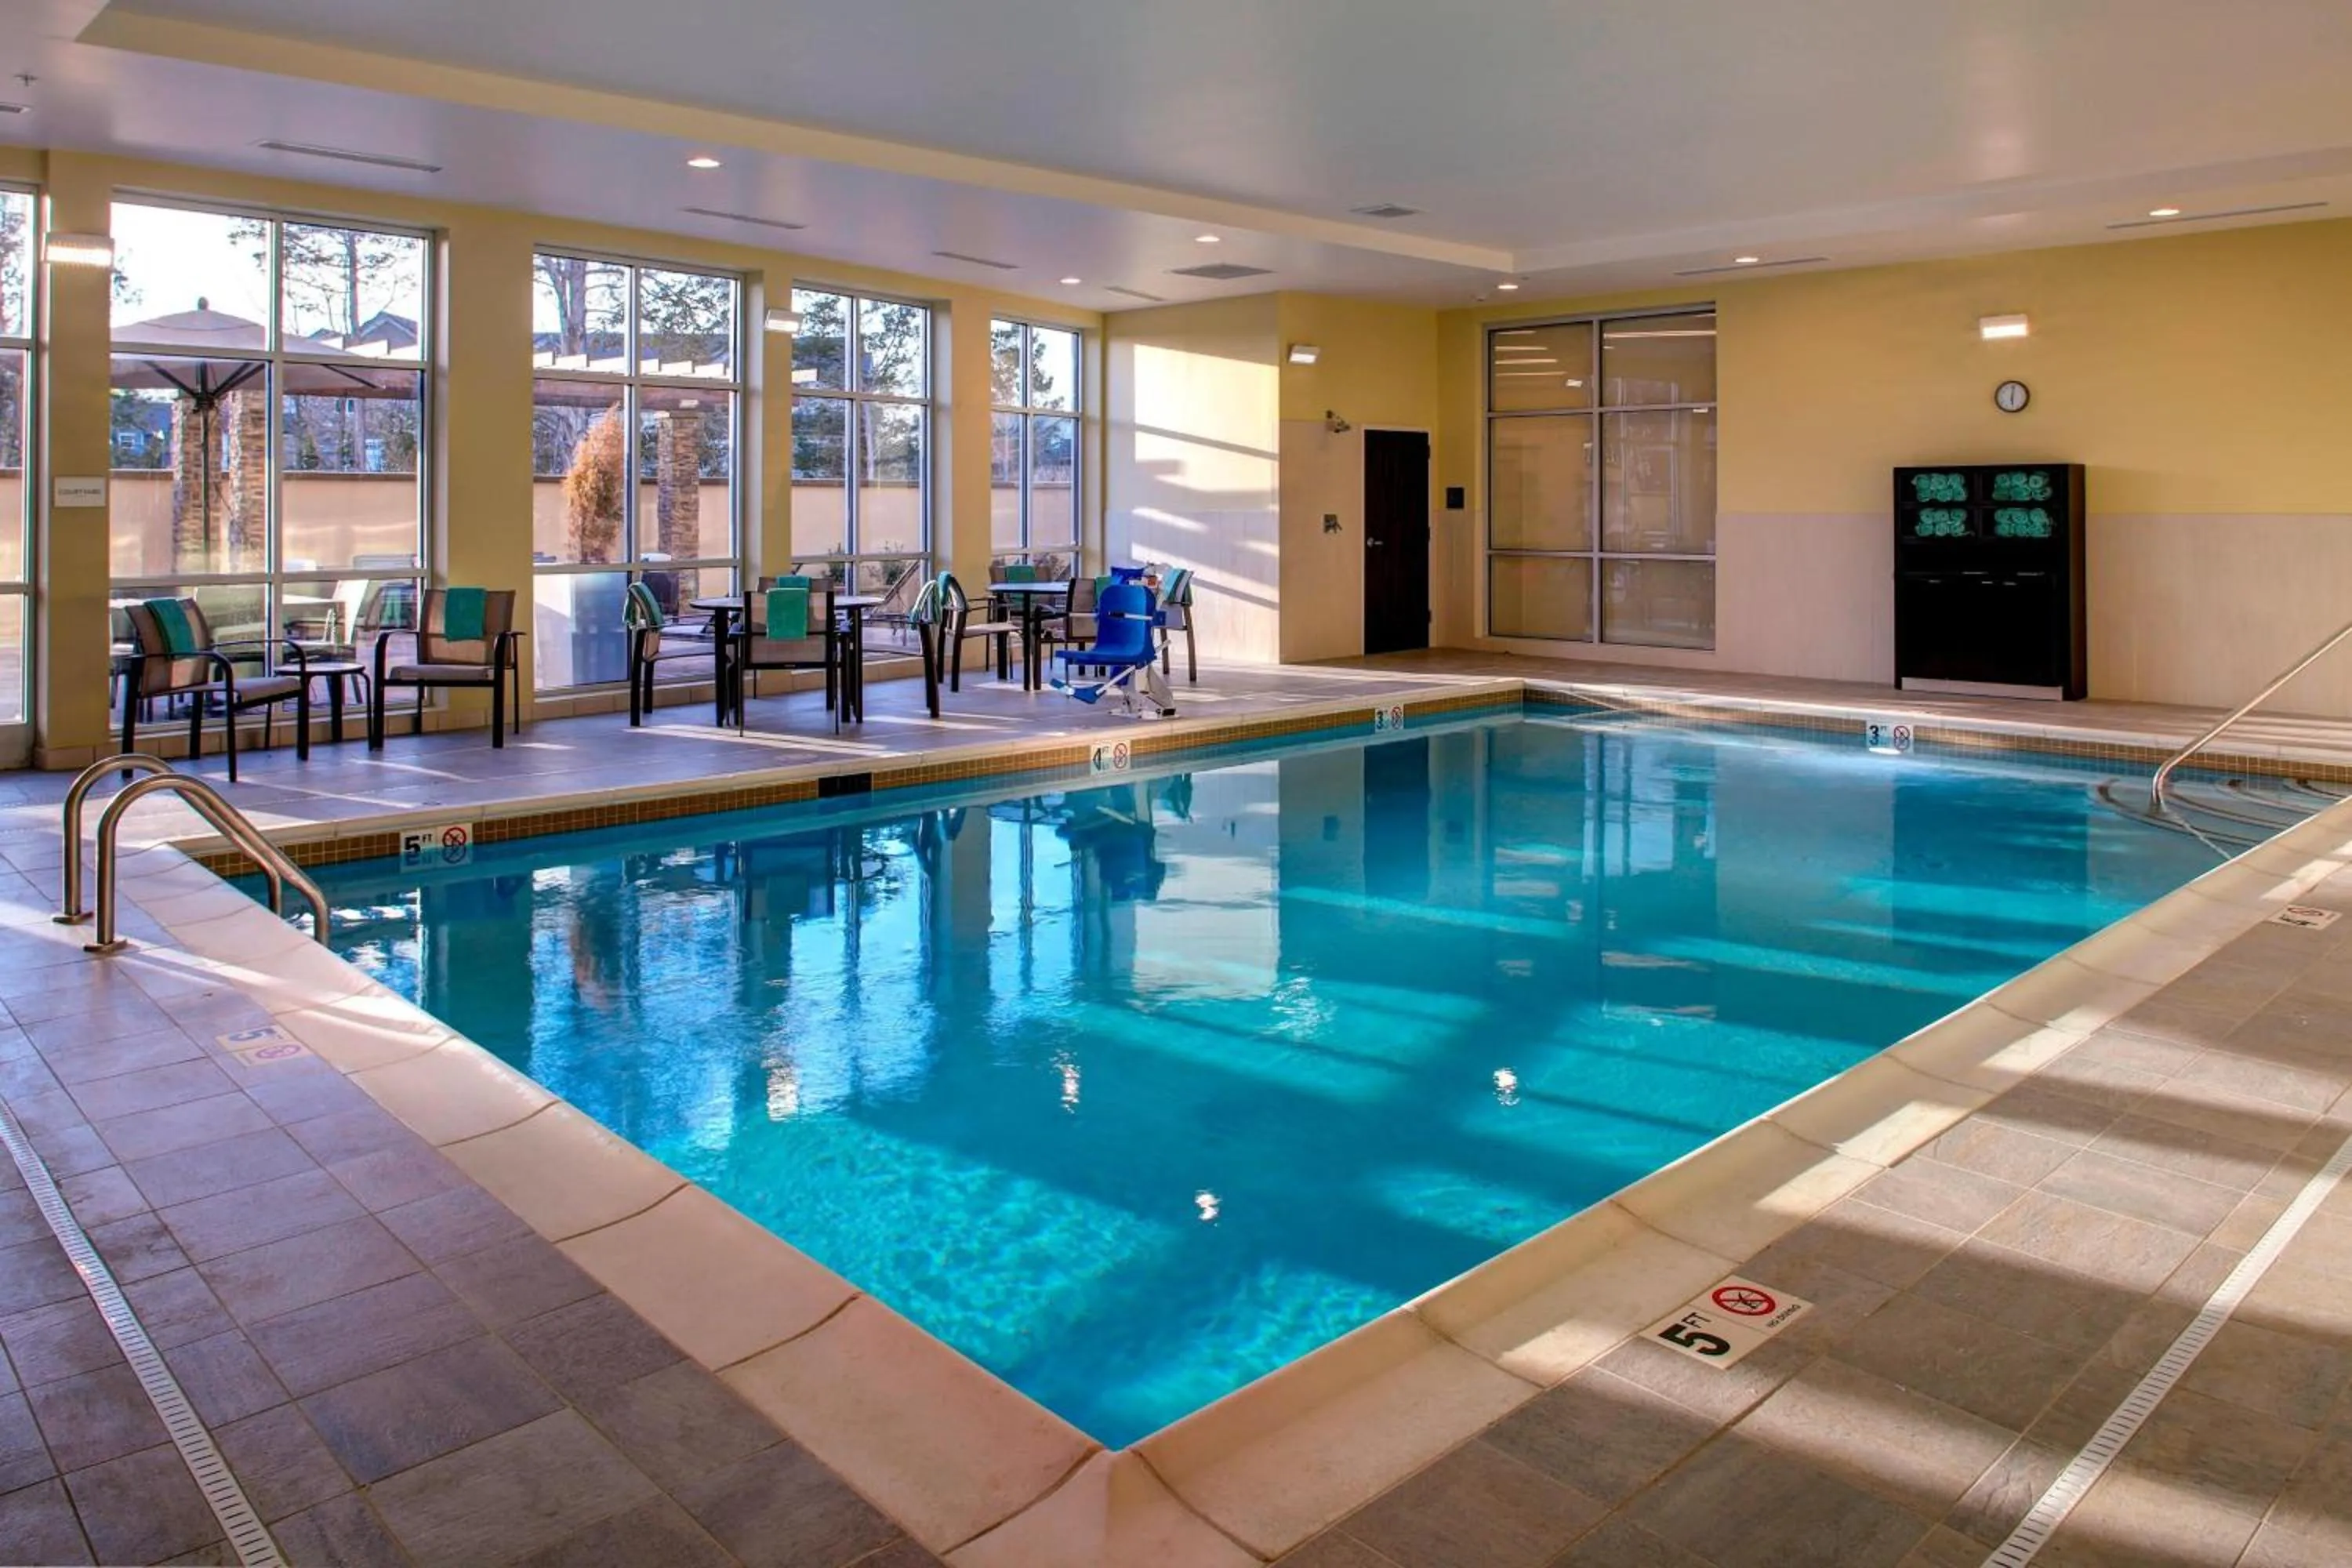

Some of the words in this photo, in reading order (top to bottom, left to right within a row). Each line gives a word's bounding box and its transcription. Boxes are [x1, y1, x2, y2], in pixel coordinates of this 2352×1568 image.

[405, 835, 420, 854] 5
[423, 833, 432, 843] FT
[228, 1028, 277, 1042] 5
[1681, 1312, 1712, 1329] FT
[1657, 1323, 1730, 1356] 5
